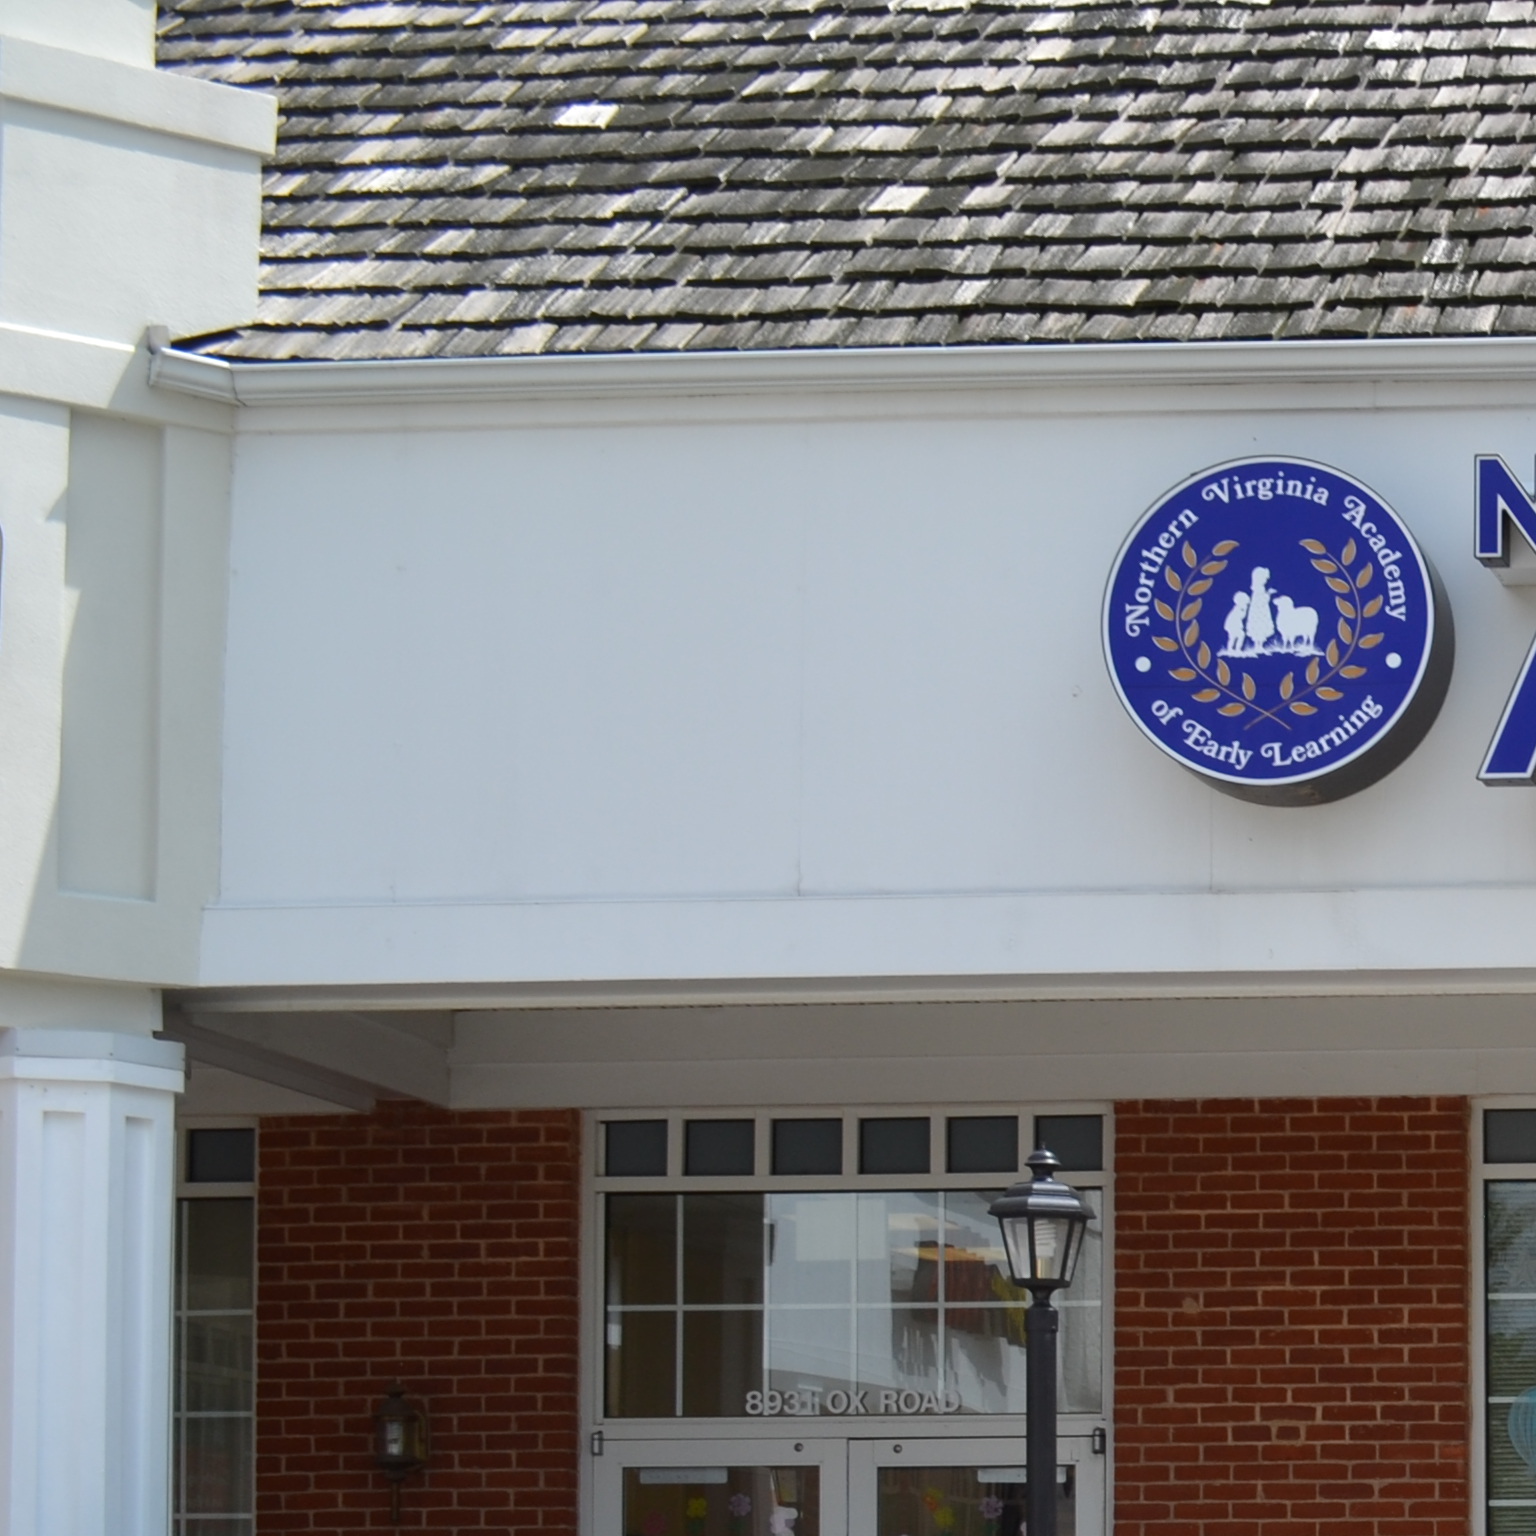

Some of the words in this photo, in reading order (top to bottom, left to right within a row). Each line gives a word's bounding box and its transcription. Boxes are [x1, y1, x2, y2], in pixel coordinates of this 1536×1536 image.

[1125, 507, 1199, 638] Northern
[1201, 471, 1330, 505] Virginia
[1341, 495, 1406, 621] Academy
[1151, 699, 1183, 725] of
[1182, 719, 1253, 770] Early
[1260, 695, 1383, 767] Learning
[826, 1389, 870, 1414] OX
[880, 1389, 962, 1414] ROAD
